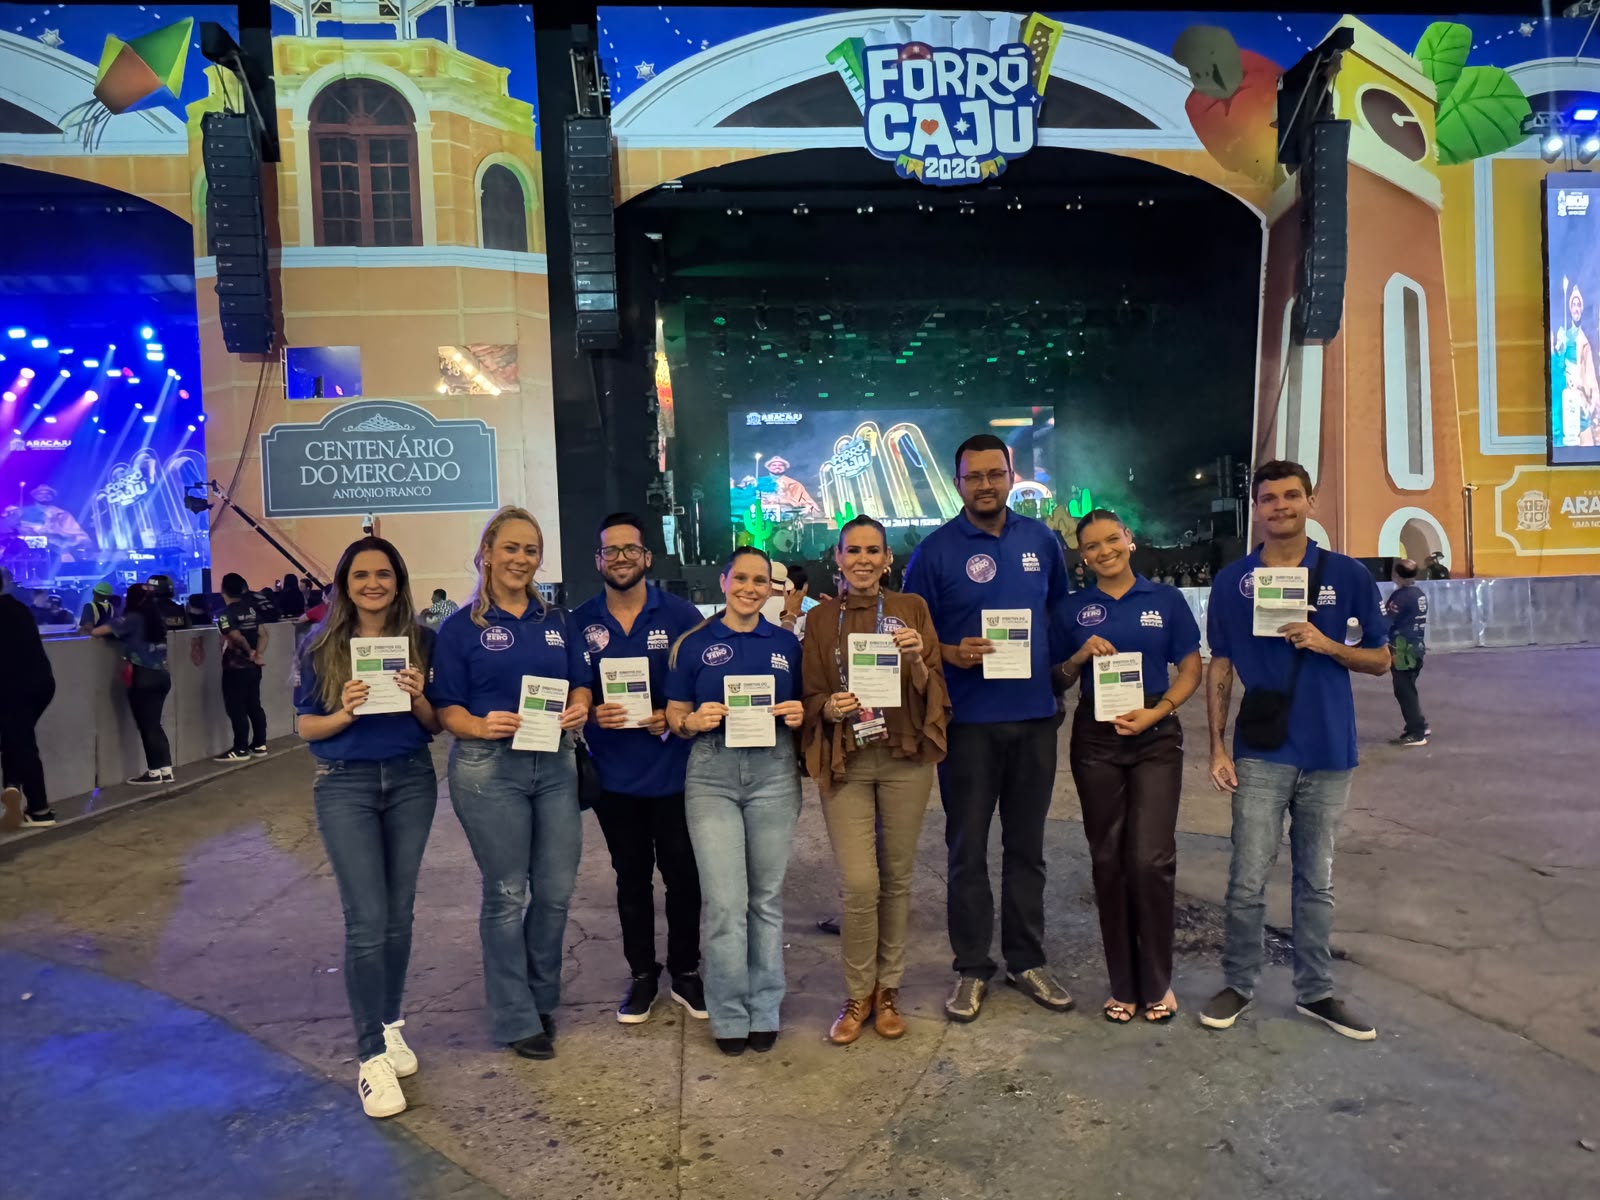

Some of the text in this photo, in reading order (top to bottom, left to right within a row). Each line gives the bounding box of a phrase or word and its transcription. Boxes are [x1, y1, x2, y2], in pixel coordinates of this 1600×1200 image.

[867, 47, 1028, 104] FORRÓ
[868, 98, 1033, 157] CAJU
[925, 156, 981, 180] 2026
[305, 435, 454, 461] CENTENÁRIO
[300, 461, 461, 486] DO MERCADO
[333, 485, 432, 499] ANTÔNIO FRANCO
[1560, 495, 1600, 514] ARA
